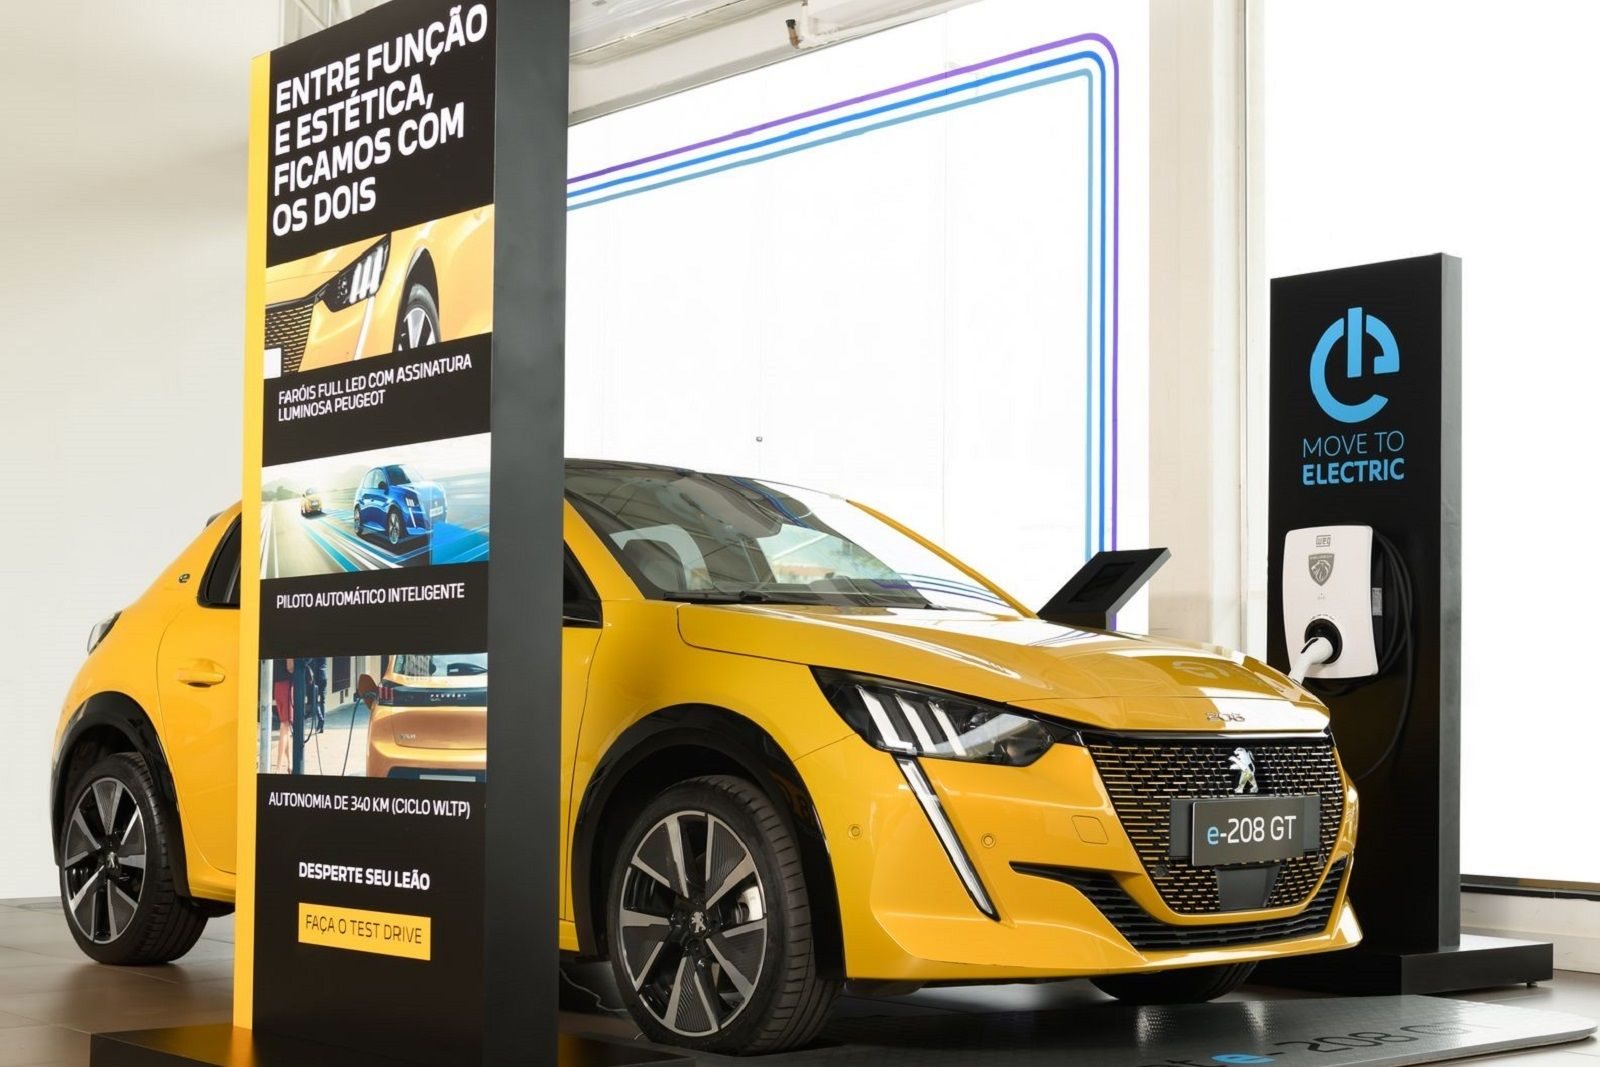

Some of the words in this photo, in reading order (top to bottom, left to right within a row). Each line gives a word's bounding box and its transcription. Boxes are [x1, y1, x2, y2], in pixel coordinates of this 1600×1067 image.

[276, 53, 360, 115] ENTRE
[366, 3, 488, 82] FUNÇÃO
[275, 121, 290, 155] E
[296, 73, 434, 150] ESTÉTICA,
[274, 127, 391, 197] FICAMOS
[398, 101, 465, 157] COM
[272, 203, 308, 237] OS
[314, 176, 377, 226] DOIS
[278, 383, 316, 404] FARÓIS
[318, 377, 343, 399] FULL
[345, 375, 367, 393] LED
[368, 368, 394, 388] COM
[396, 353, 472, 383] ASSINATURA
[278, 397, 332, 422] LUMINOSA
[334, 389, 386, 413] PEUGEOT
[1302, 432, 1367, 458] MOVE
[1374, 430, 1405, 454] TO
[1302, 458, 1405, 486] ELECTRIC
[277, 592, 314, 609] PILOTO
[315, 586, 386, 608] AUTOMÁTICO
[388, 583, 465, 603] INTELIGENTE
[268, 791, 331, 809] AUTONOMIA
[334, 794, 348, 810] DE
[350, 795, 371, 811] 340
[372, 796, 390, 813] KM
[392, 797, 430, 815] (CICLO
[432, 800, 471, 820] WLTP)
[1206, 816, 1265, 845] e-208
[1270, 815, 1297, 841] GT
[299, 861, 363, 884] DESPERTE
[365, 868, 392, 887] SEU
[394, 869, 431, 891] LEÃO
[305, 914, 335, 935] FAÇA
[338, 918, 347, 934] O
[350, 920, 380, 939] TEST
[384, 923, 422, 944] DRIVE
